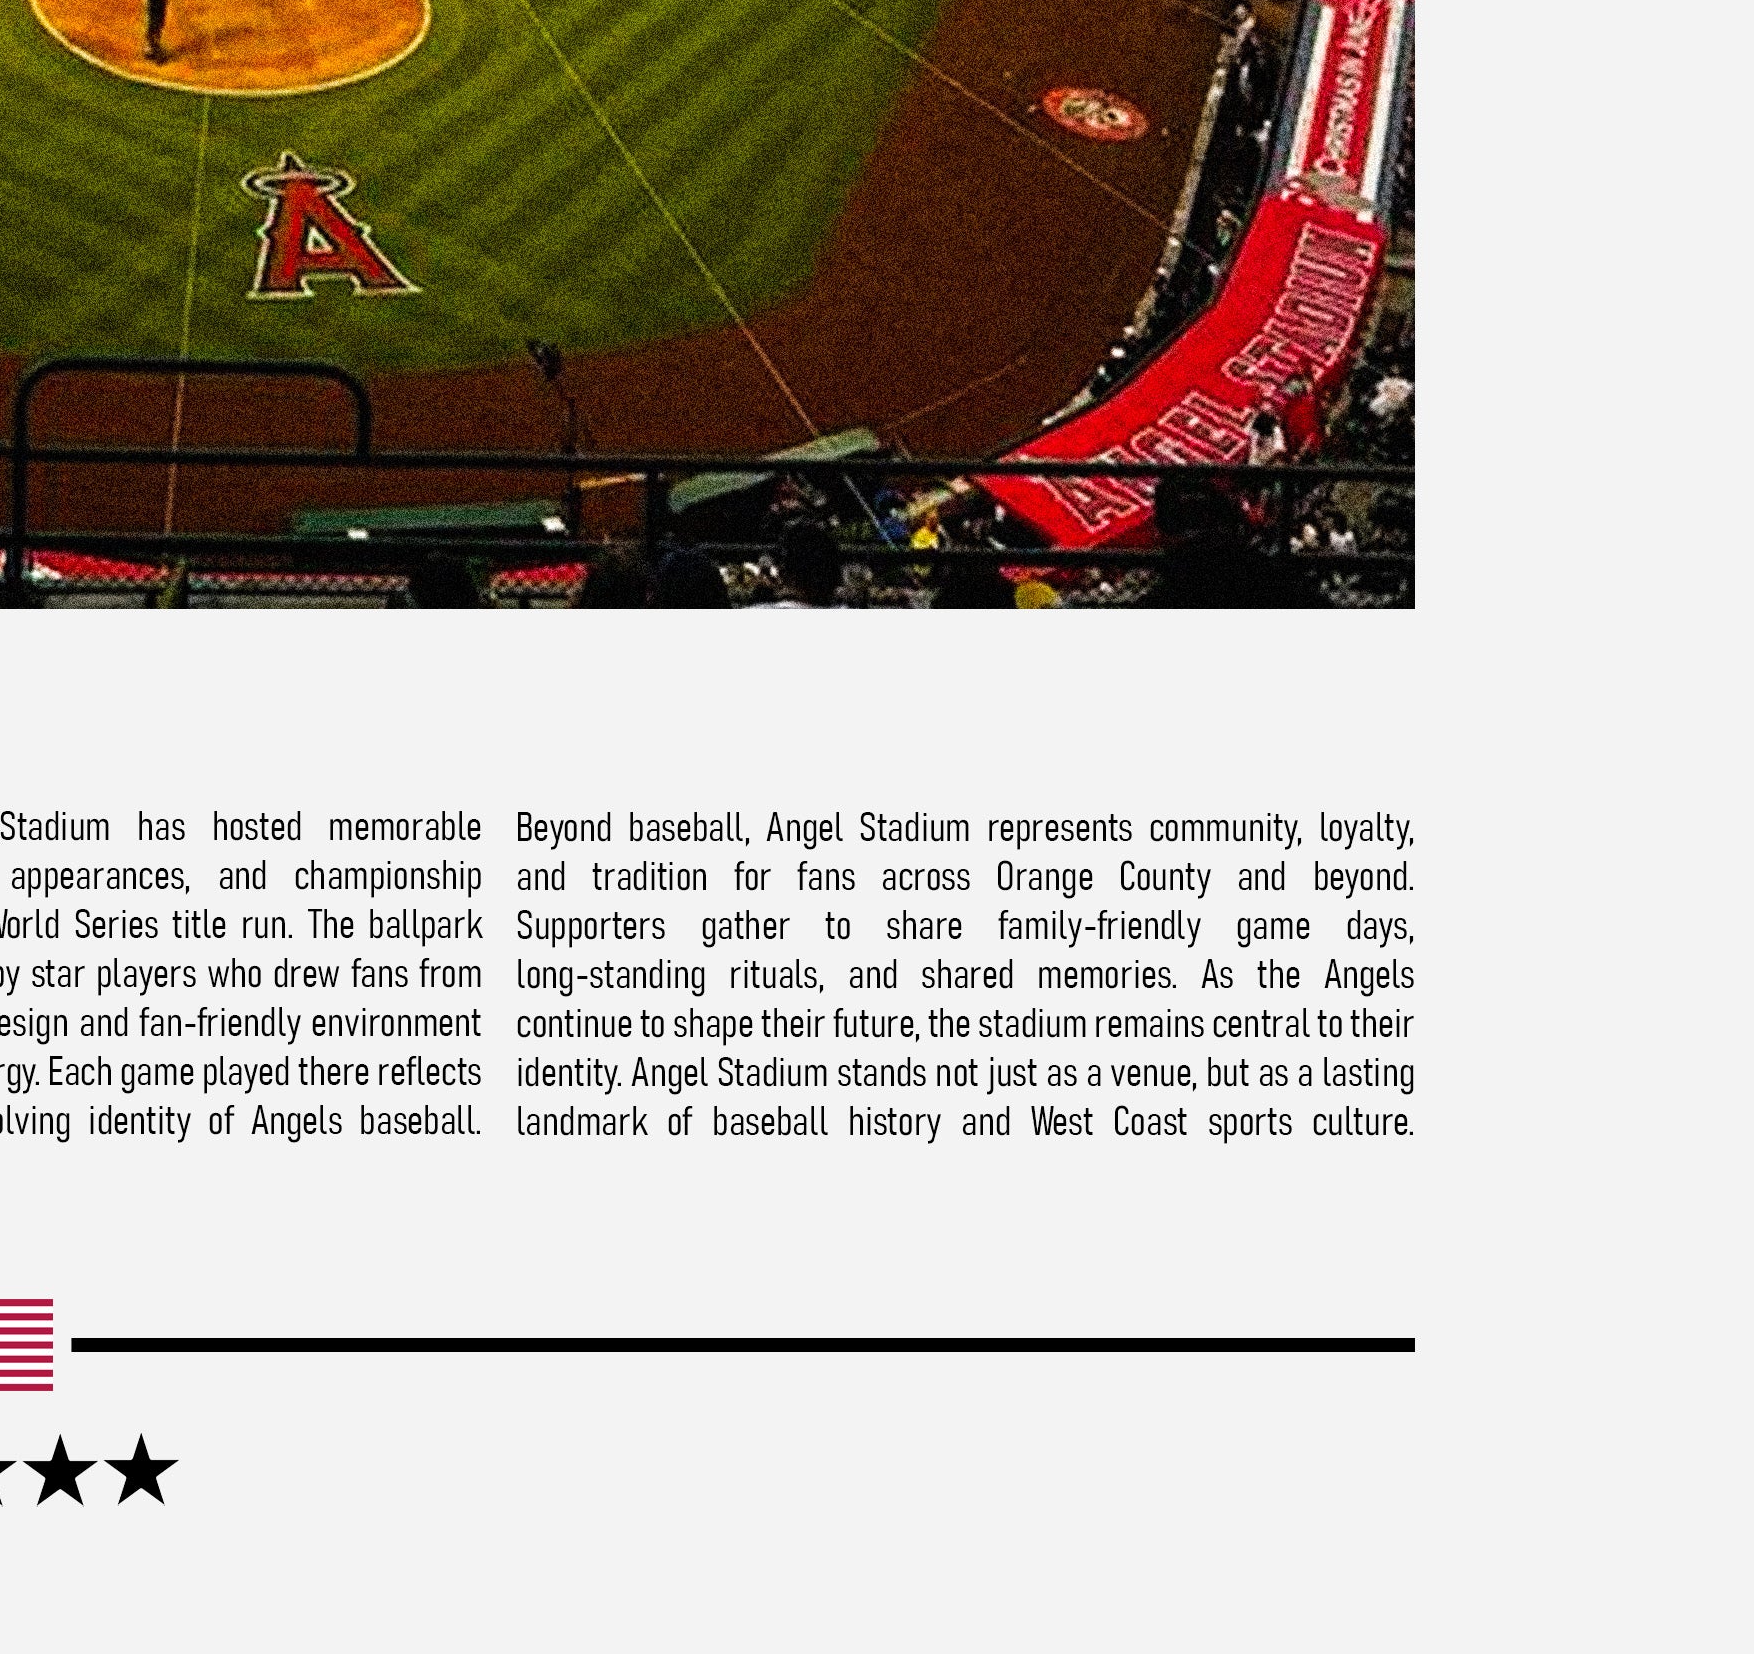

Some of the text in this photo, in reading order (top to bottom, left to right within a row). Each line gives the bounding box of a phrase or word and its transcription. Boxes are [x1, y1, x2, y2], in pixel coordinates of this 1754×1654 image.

[240, 150, 423, 301] A
[1, 811, 109, 840] Stadium
[139, 811, 185, 840] has
[214, 811, 300, 840] hosted
[330, 811, 480, 840] memorable
[518, 812, 1413, 850] Beyond baseball, Angel Stadium represents community, loyalty,
[12, 868, 189, 898] appearances,
[220, 860, 265, 889] and
[296, 860, 481, 898] championship
[518, 860, 1413, 899] and tradition for fans across Orange County and beyond.
[518, 910, 1413, 948] Supporters gather to share family-friendly game days,
